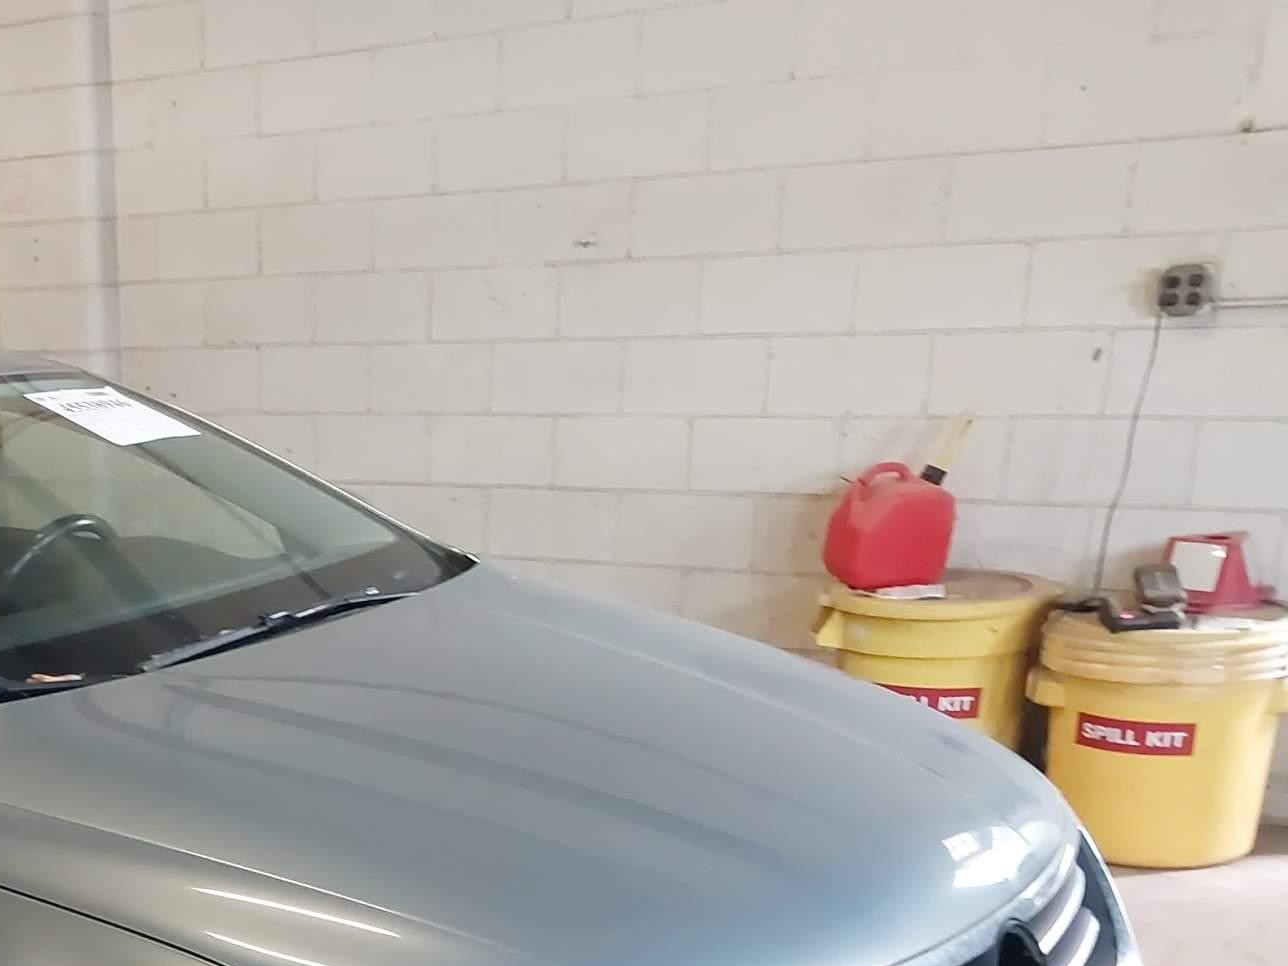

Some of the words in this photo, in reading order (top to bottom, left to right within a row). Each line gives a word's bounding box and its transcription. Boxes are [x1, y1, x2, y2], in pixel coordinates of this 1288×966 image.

[938, 696, 975, 712] KIT
[1081, 722, 1141, 746] SPILL
[1145, 730, 1189, 748] KIT
